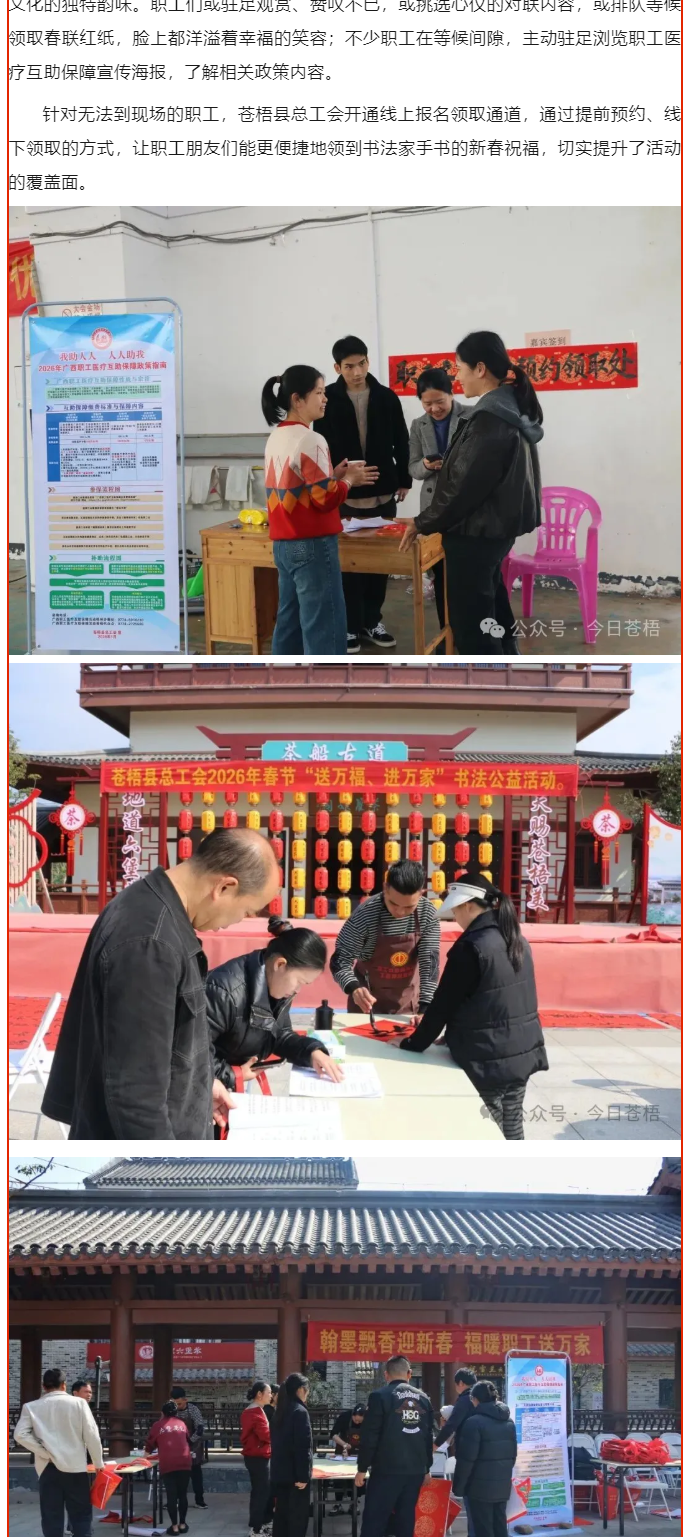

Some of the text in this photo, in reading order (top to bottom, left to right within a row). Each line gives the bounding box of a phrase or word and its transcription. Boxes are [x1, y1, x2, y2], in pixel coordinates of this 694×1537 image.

[59, 350, 145, 362] 我助人人 人人助我
[39, 361, 167, 372] 2026年广西职工医疗互助保障政策指南
[281, 741, 389, 761] 茶船古道
[64, 807, 81, 826] 茶
[597, 813, 617, 833] 茶
[122, 792, 145, 888] 地道六堡
[172, 1346, 203, 1355] 六堡茶
[320, 1328, 592, 1357] 翰墨飘香迎新春 福暖职工送万家
